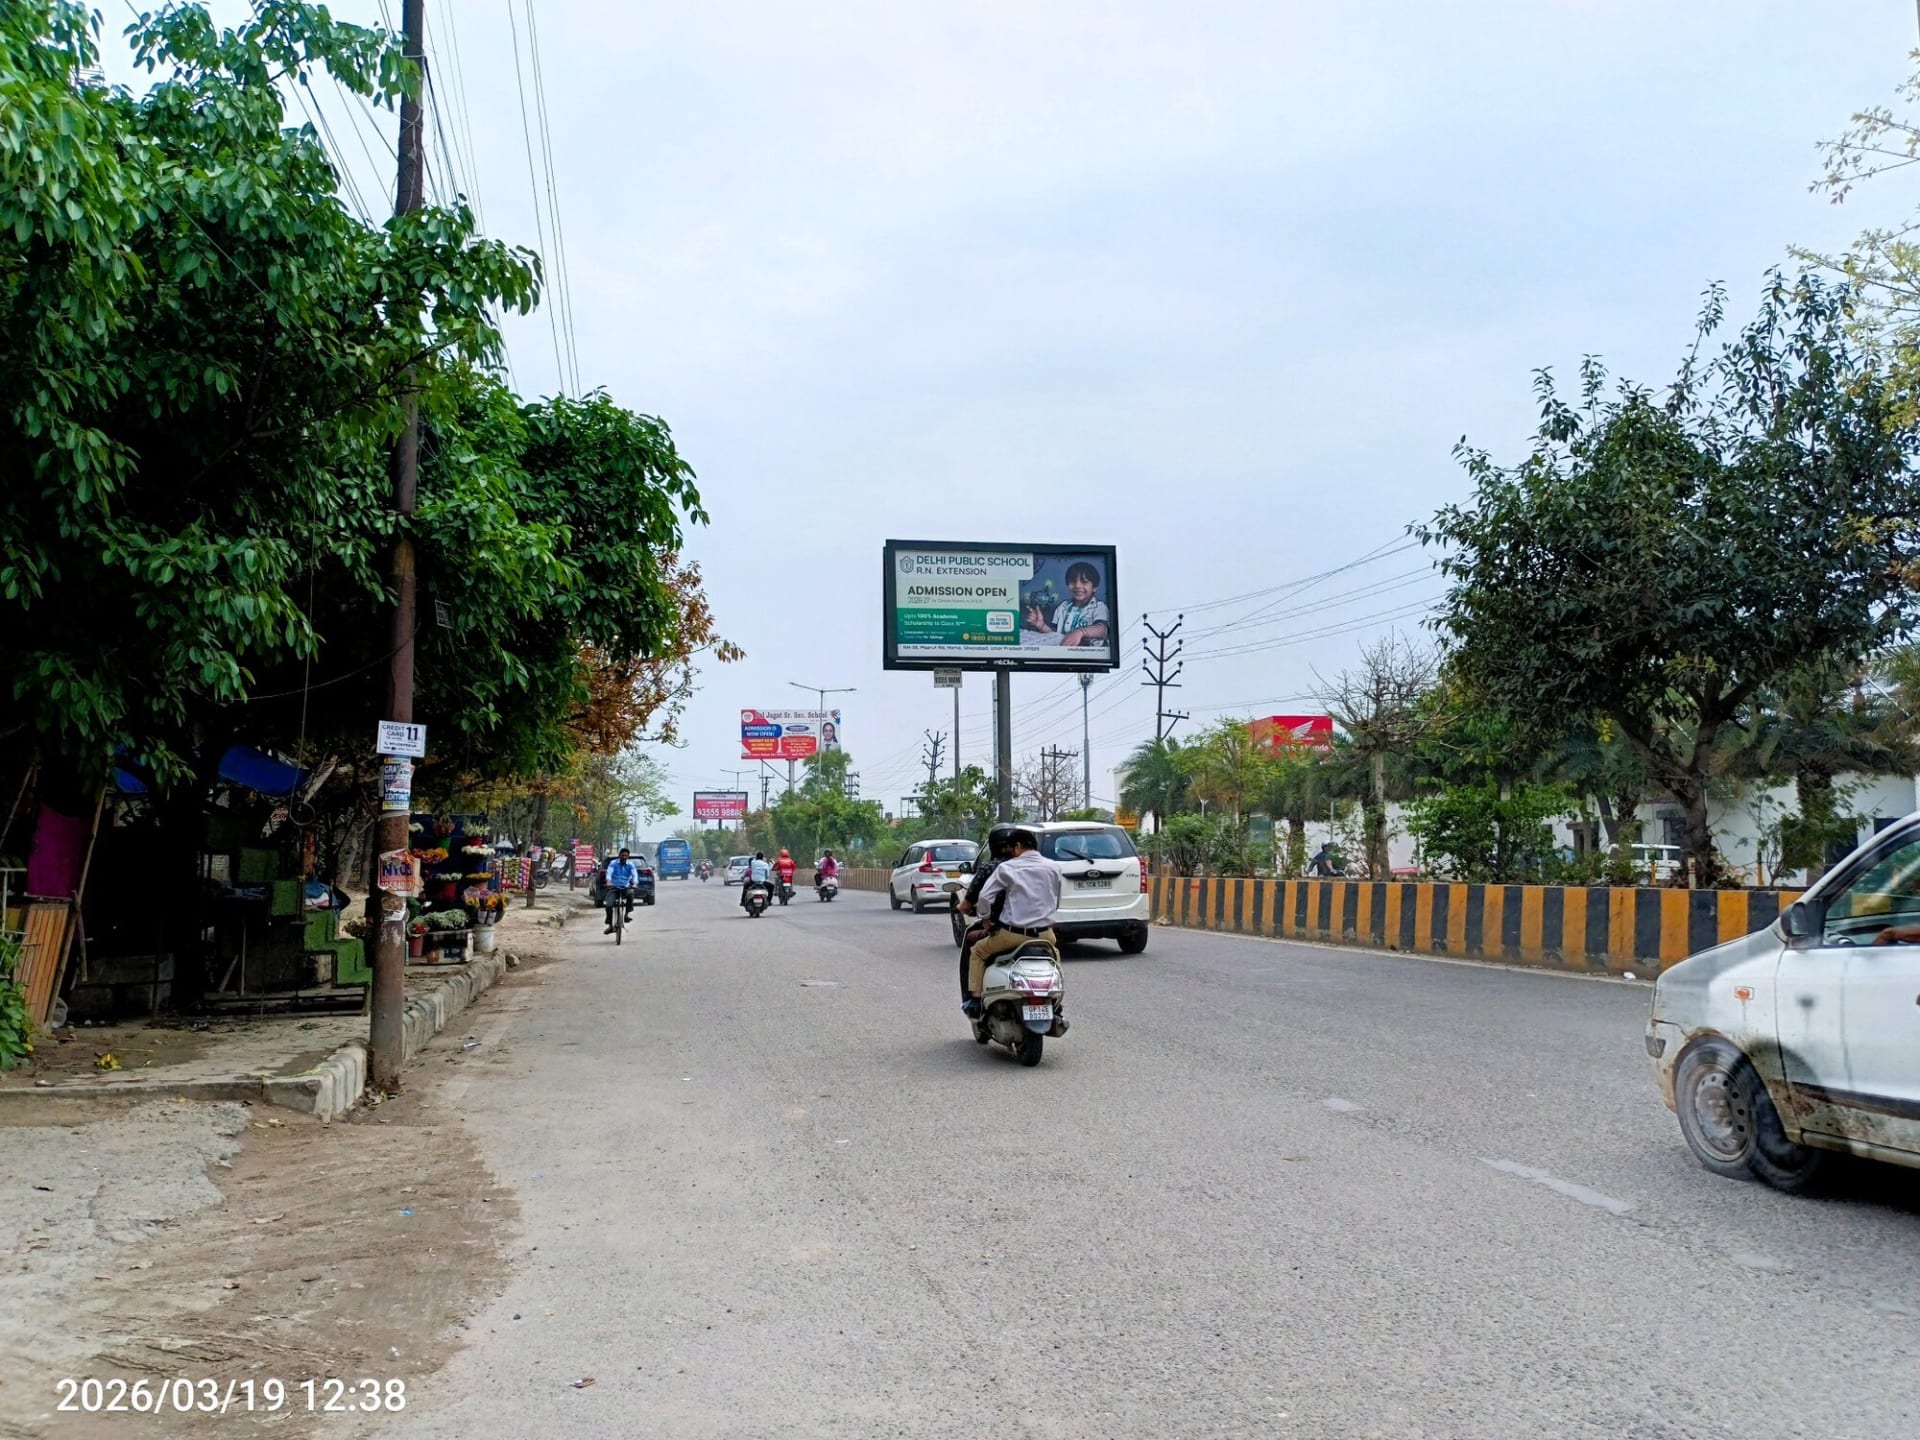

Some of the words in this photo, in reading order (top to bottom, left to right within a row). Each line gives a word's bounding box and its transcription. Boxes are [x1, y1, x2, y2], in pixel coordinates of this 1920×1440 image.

[916, 555, 946, 565] DELHI
[948, 556, 985, 566] PUBLIC
[987, 557, 1031, 567] SCHOOL
[916, 567, 934, 575] R.N.
[936, 567, 987, 576] EXTENSION
[907, 586, 973, 596] ADMISSION
[975, 587, 1007, 597] OPEN
[807, 711, 828, 719] School
[697, 807, 720, 817] 93555
